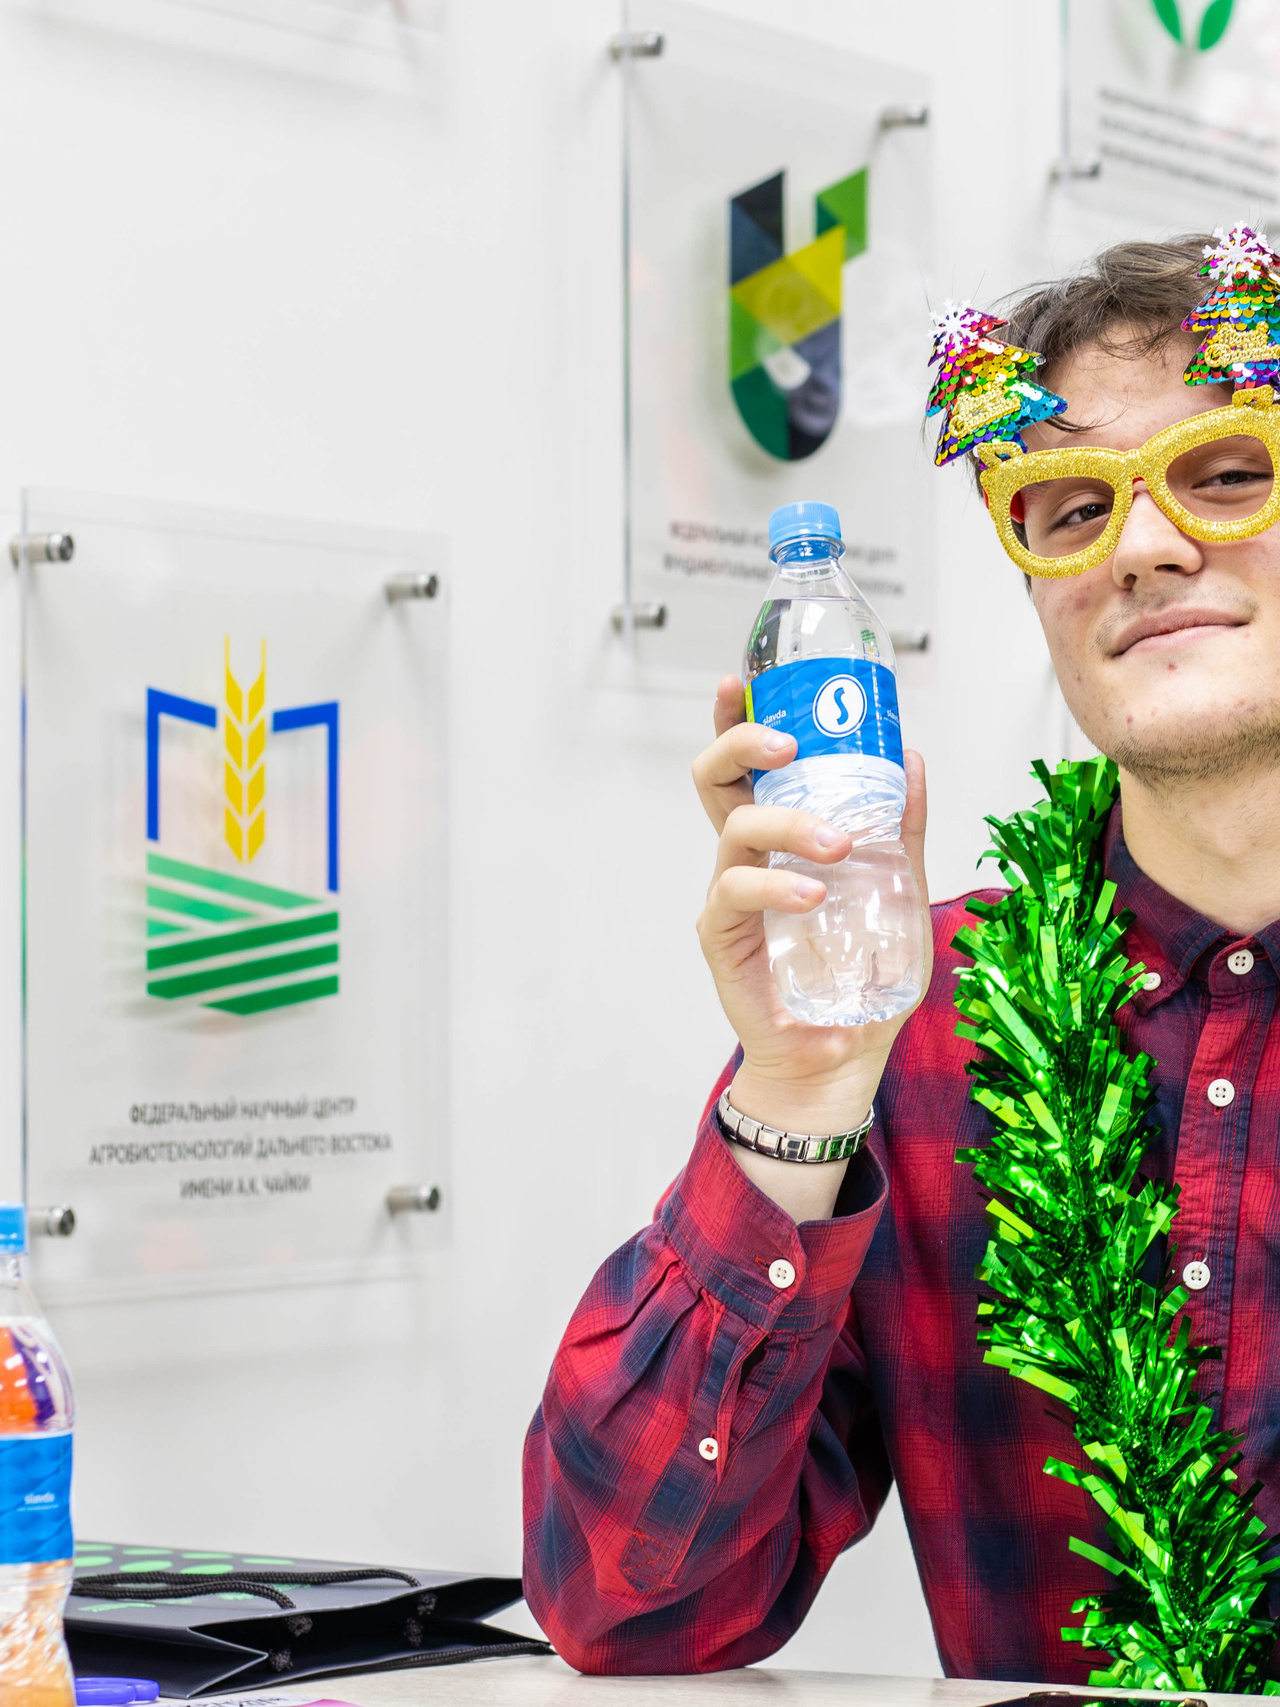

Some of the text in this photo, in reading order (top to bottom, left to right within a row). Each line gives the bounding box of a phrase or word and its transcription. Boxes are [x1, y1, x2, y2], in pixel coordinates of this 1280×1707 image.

[762, 709, 787, 726] slavda
[129, 1094, 356, 1125] ФЕДЕРАЛЬНЫЙ НАУЧНЫЙ ЦЕНТР
[89, 1133, 393, 1165] АГРОБИОТЕХНОЛОГИЙ ДАЛЬНЕГО ВОСТОКА
[179, 1177, 233, 1199] ИМЕНИ
